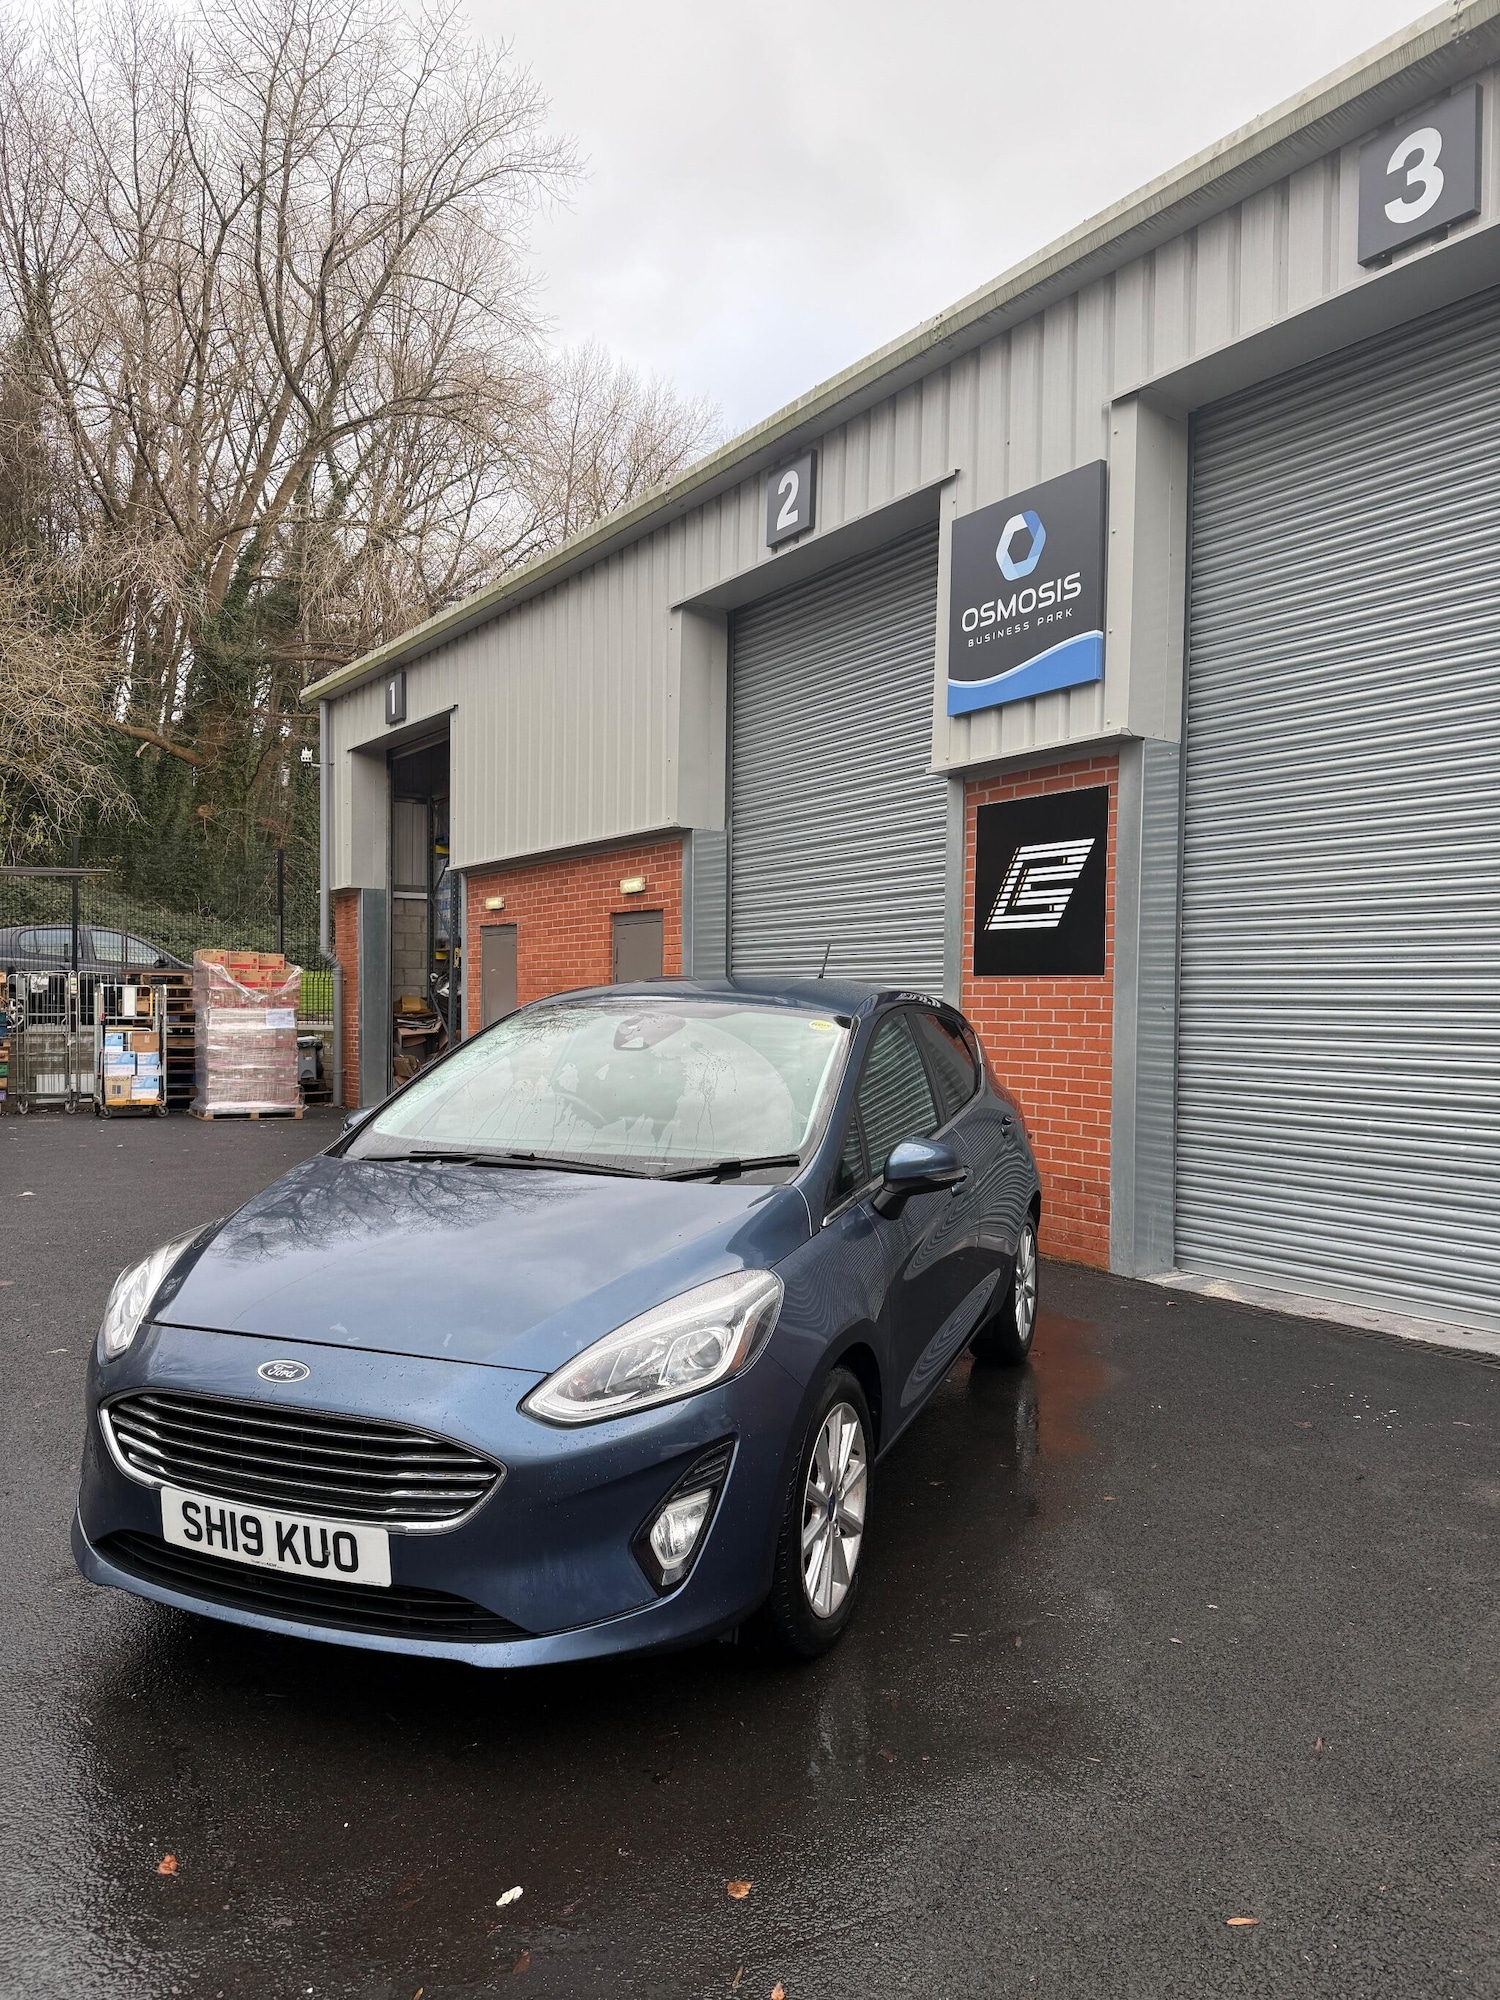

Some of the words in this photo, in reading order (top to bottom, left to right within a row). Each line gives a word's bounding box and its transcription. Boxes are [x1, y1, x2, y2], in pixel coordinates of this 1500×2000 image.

[1385, 127, 1444, 223] 3
[777, 470, 799, 531] 2
[961, 572, 1082, 632] OSMOSIS
[968, 621, 1030, 647] BUSINESS
[1037, 608, 1073, 627] PARK
[389, 681, 396, 715] 1
[267, 1363, 299, 1378] Ford
[181, 1501, 264, 1556] SH19
[275, 1520, 359, 1573] KUO
